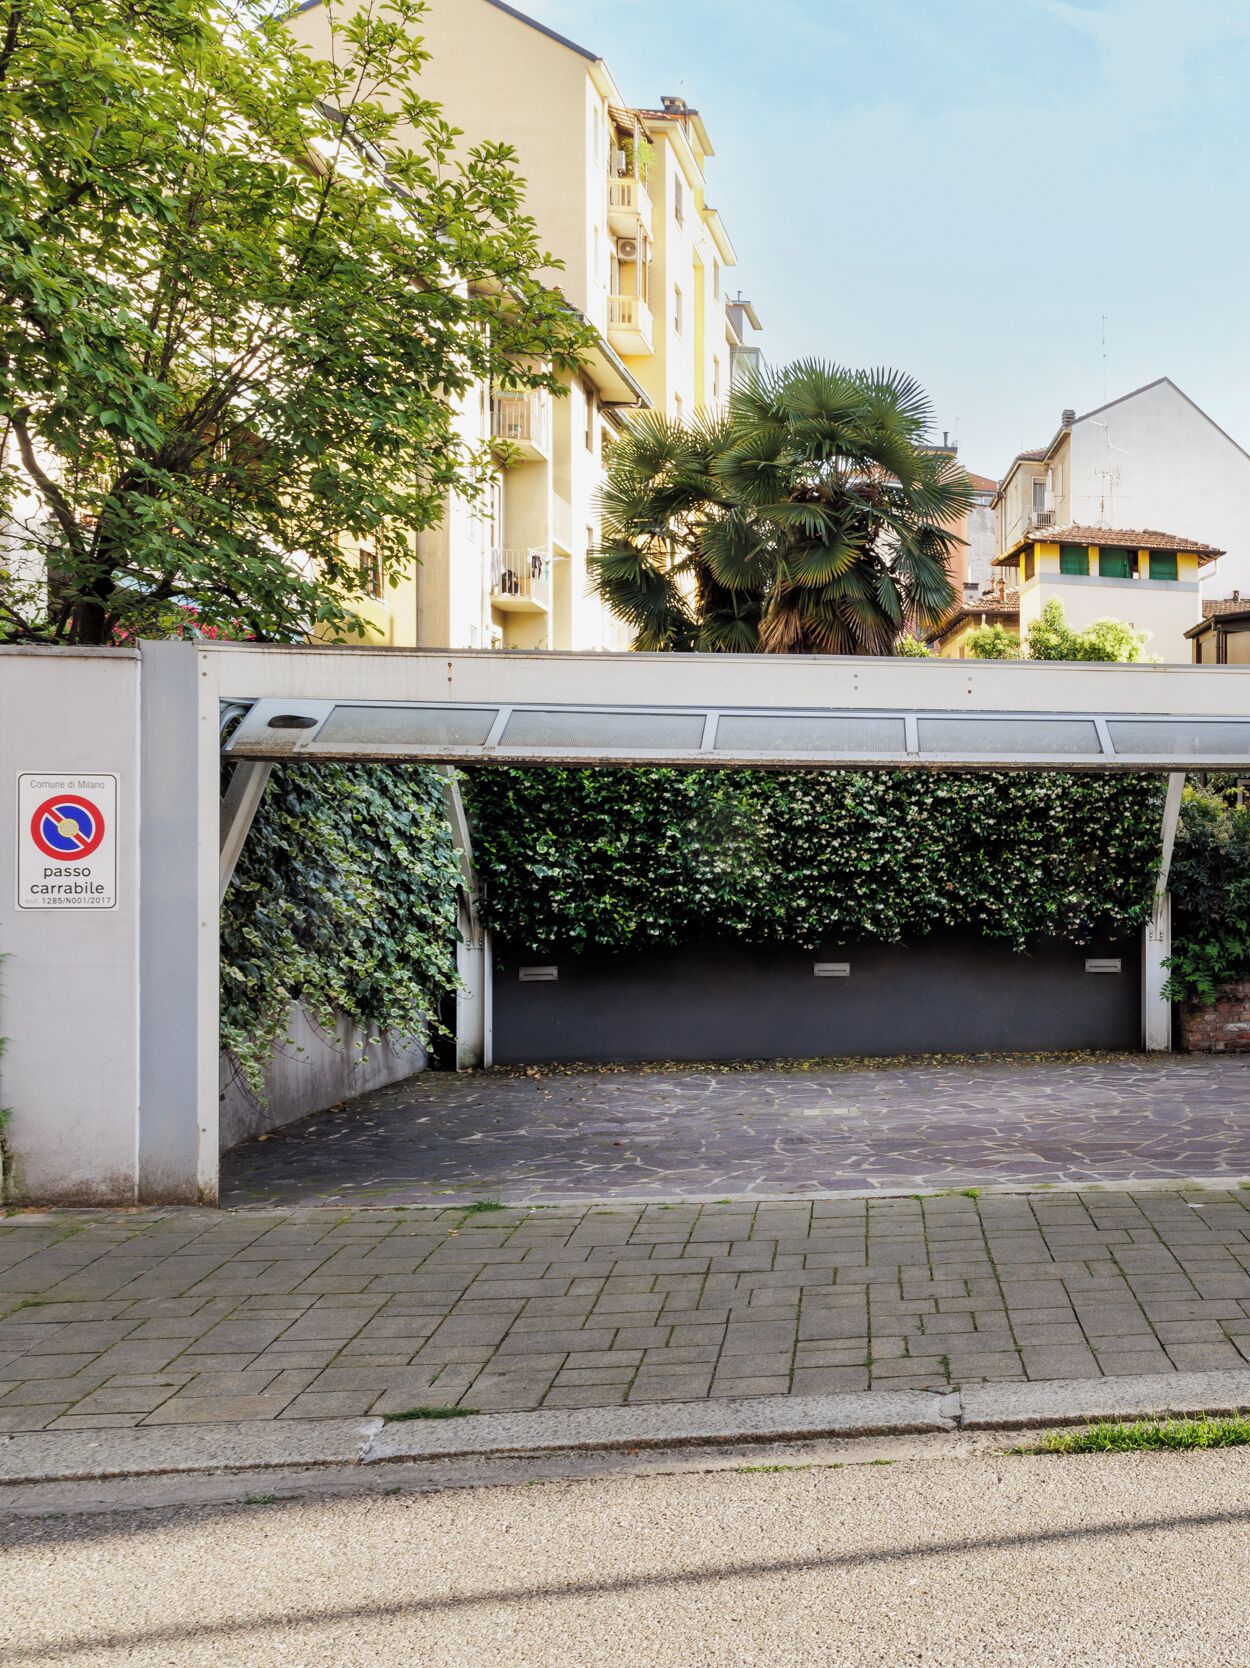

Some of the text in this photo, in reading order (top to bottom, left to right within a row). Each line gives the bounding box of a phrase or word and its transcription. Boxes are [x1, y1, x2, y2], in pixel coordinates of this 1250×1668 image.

[30, 779, 105, 789] Comune di Milano
[44, 867, 91, 879] passo
[30, 881, 104, 894] carrabile
